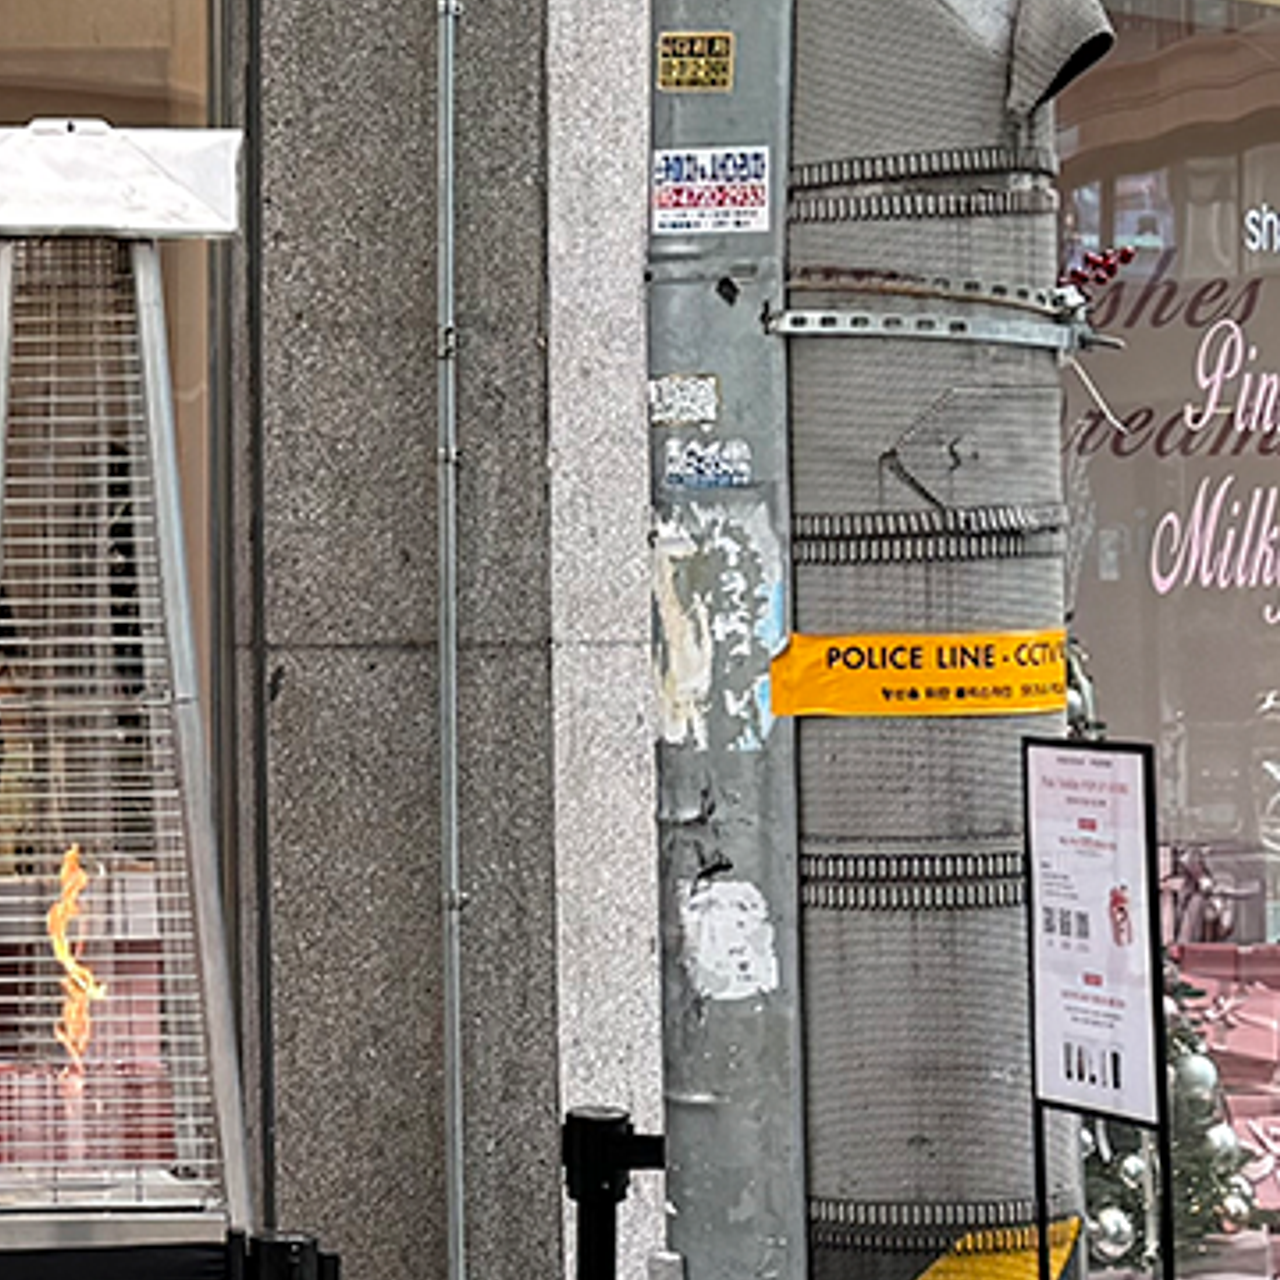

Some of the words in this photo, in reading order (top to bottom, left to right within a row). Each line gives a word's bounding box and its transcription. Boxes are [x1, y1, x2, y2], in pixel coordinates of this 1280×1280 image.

[1151, 475, 1280, 624] Milk
[827, 646, 924, 670] POLICE
[936, 645, 996, 669] LINE
